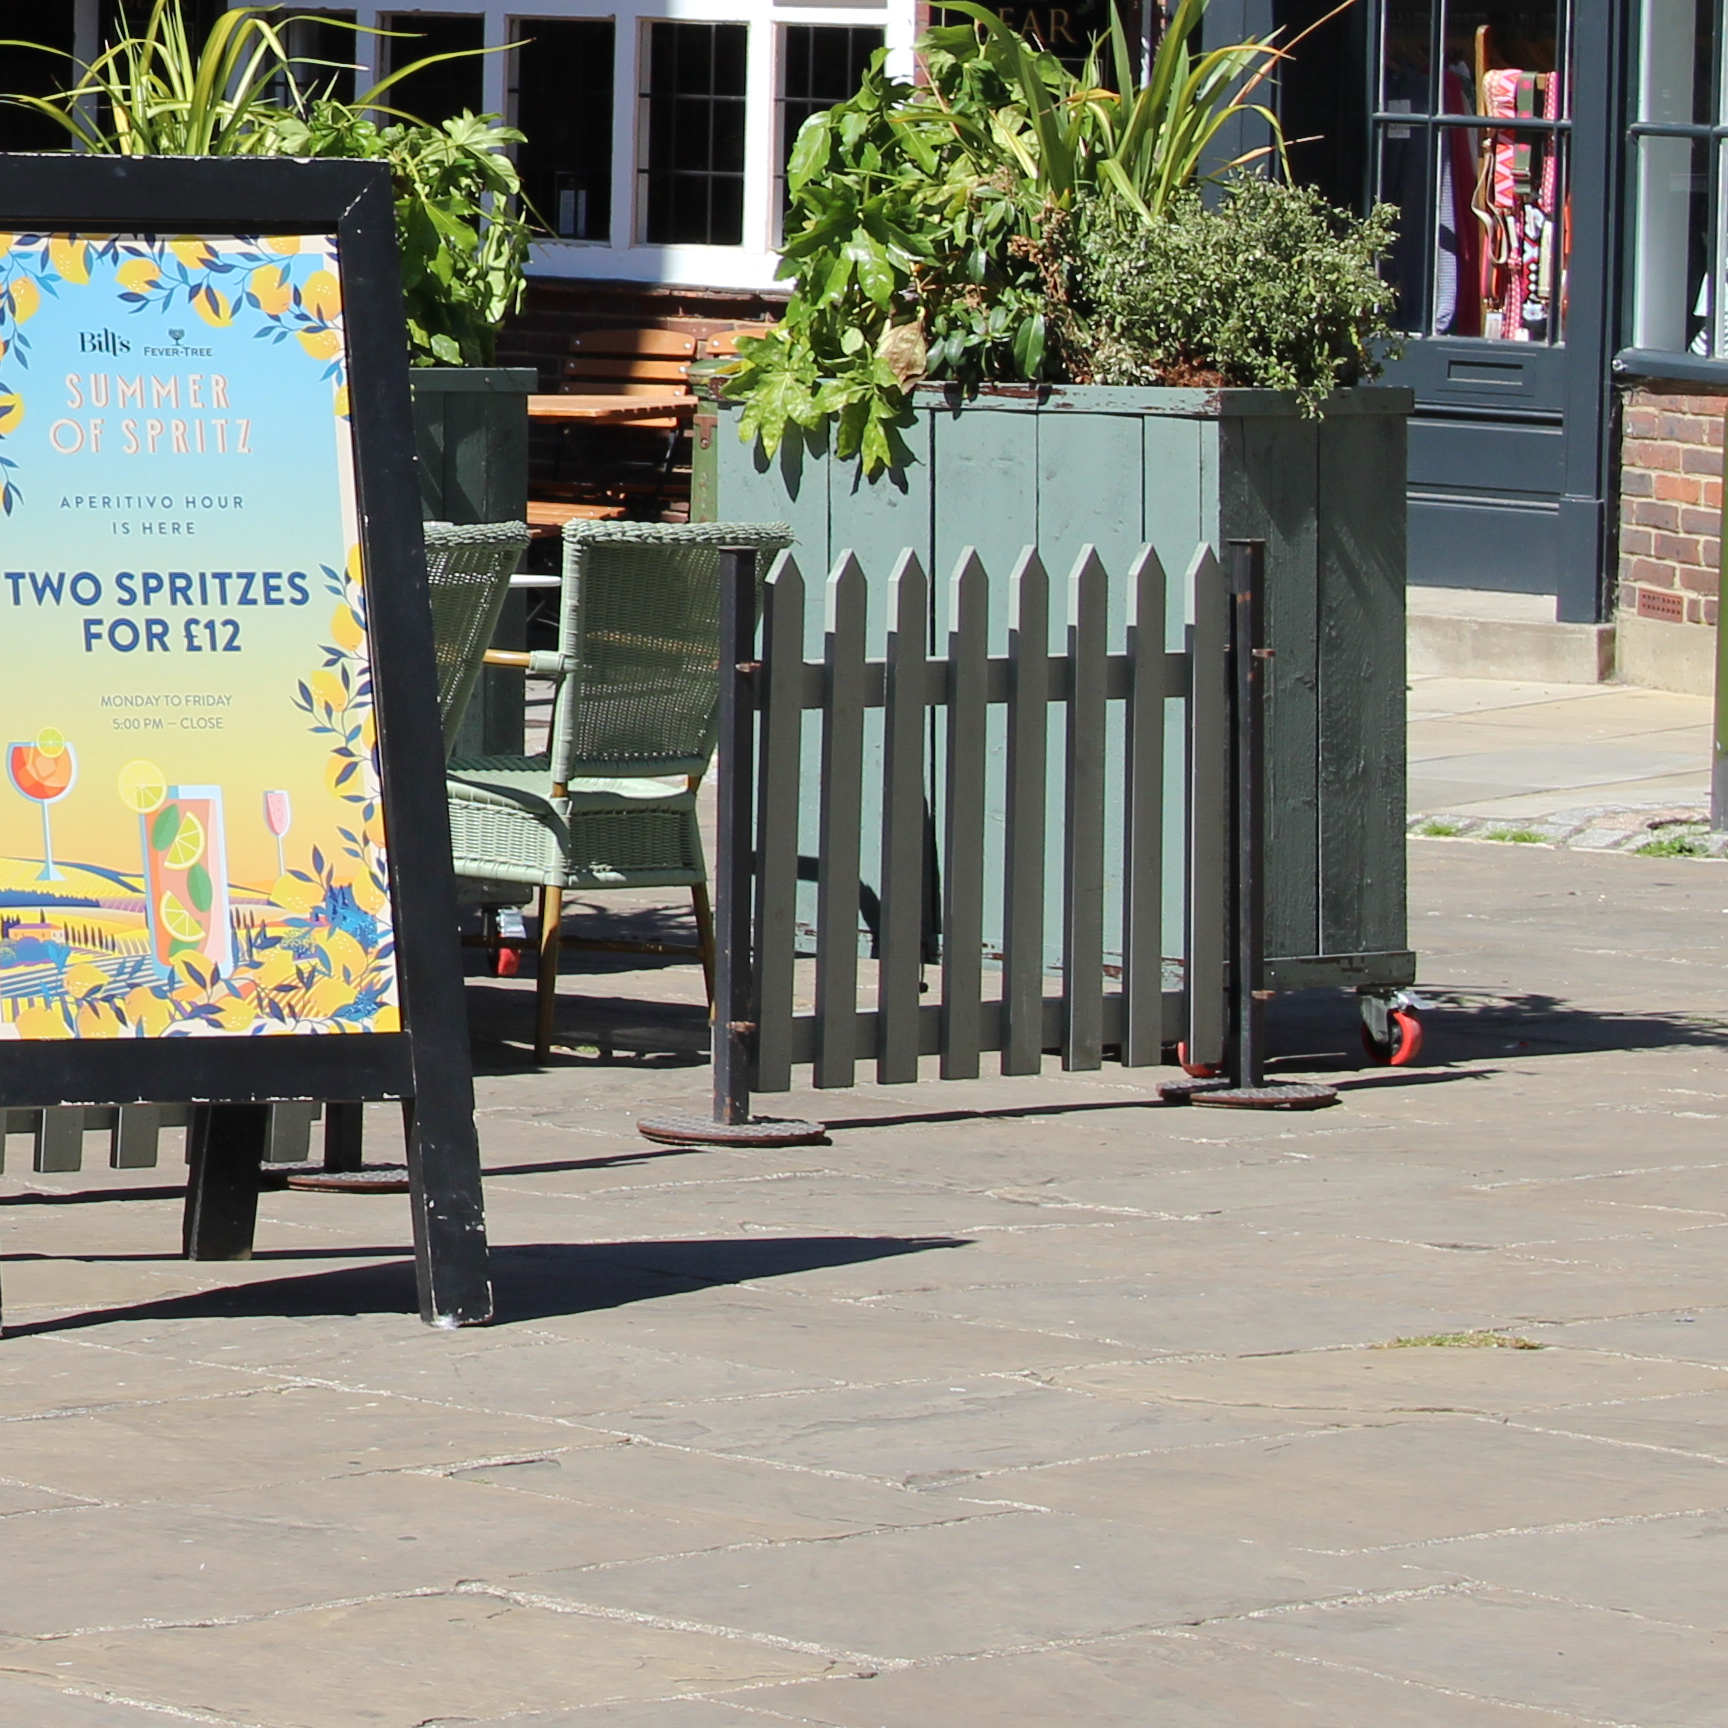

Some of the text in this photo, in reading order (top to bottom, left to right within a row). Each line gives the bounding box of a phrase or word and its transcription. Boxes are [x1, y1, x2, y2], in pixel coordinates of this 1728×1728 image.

[994, 6, 1078, 45] EAR
[79, 327, 131, 357] Bill's
[65, 373, 231, 409] SUMMER
[49, 418, 253, 454] OF SPRITZ
[60, 496, 244, 509] APERITIVO HOUR
[112, 522, 196, 535] IS HERE
[3, 571, 310, 606] TWO SPRITZES
[83, 618, 242, 652] FOR £12
[100, 694, 233, 708] MONDAY TO FRIDAY
[112, 717, 140, 730] 5:00
[143, 717, 164, 729] PM
[179, 717, 223, 729] CLOSE
